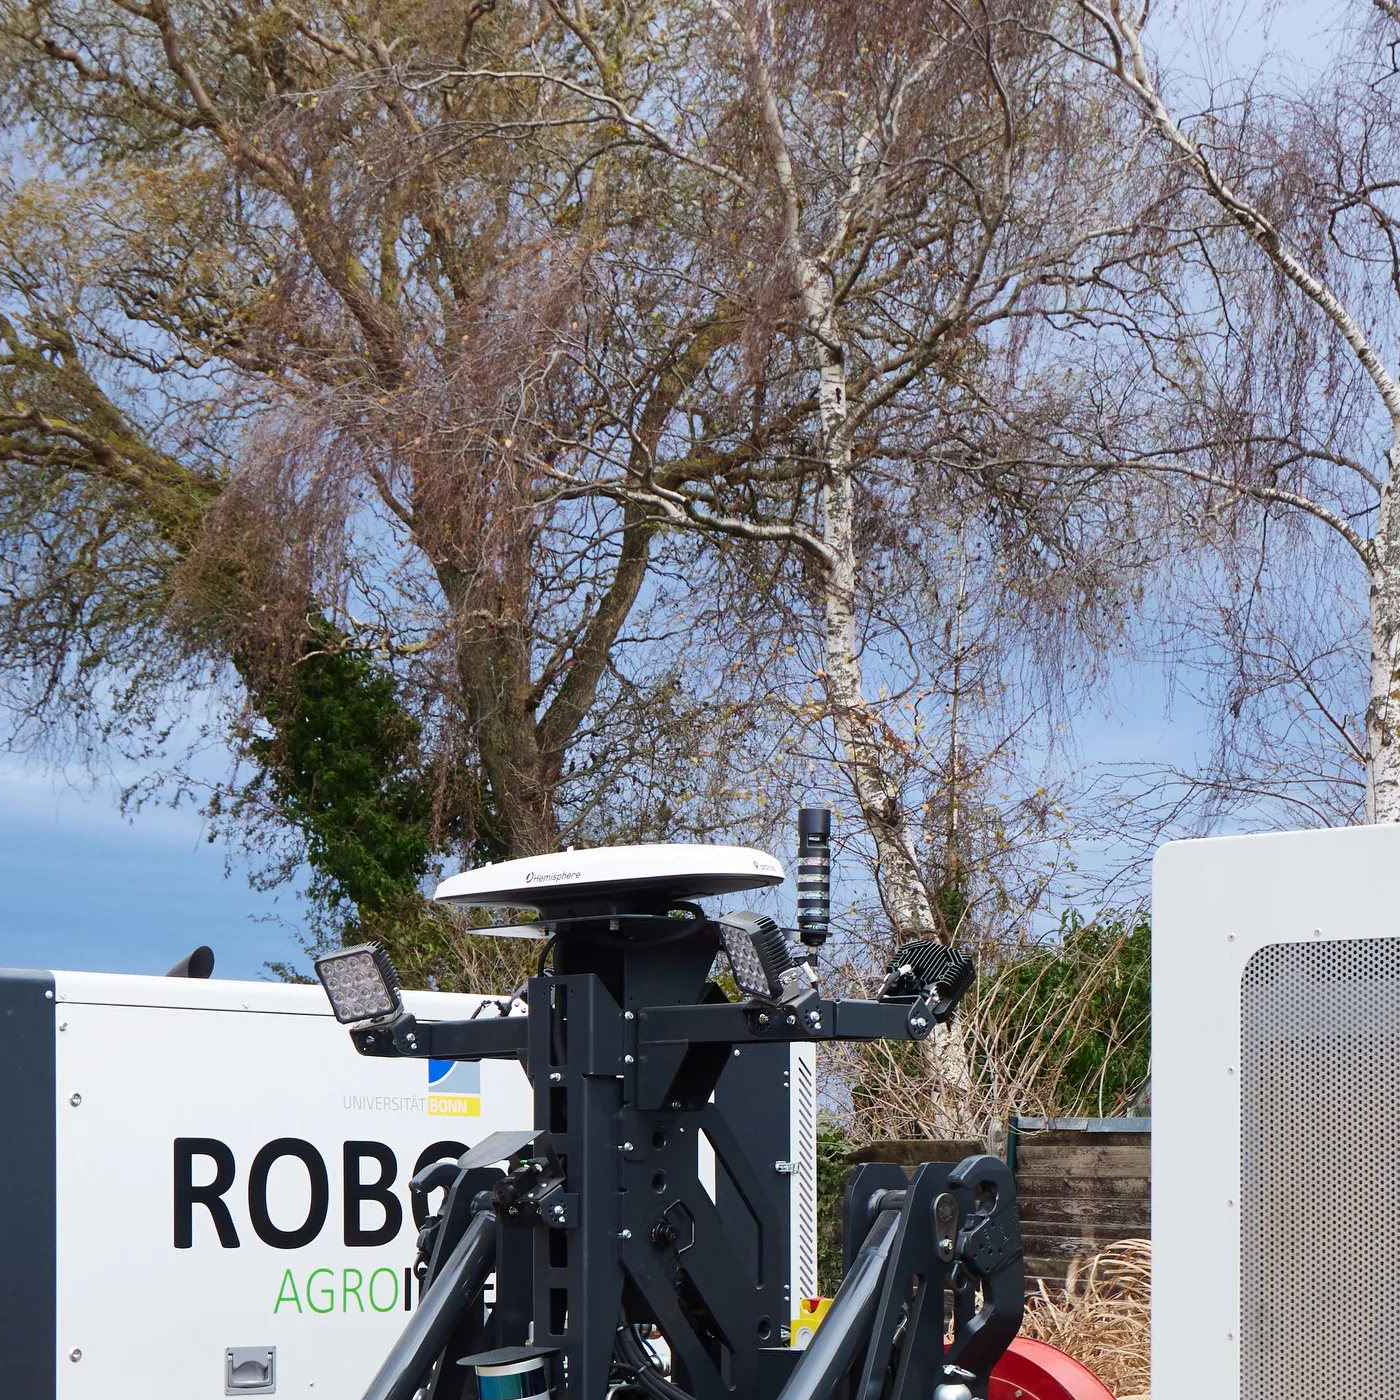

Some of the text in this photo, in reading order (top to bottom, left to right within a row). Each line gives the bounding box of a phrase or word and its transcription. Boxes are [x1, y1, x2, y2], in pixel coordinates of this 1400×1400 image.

[533, 871, 581, 883] Hemisphere
[343, 1095, 467, 1113] UNIVERSITÄT BONN
